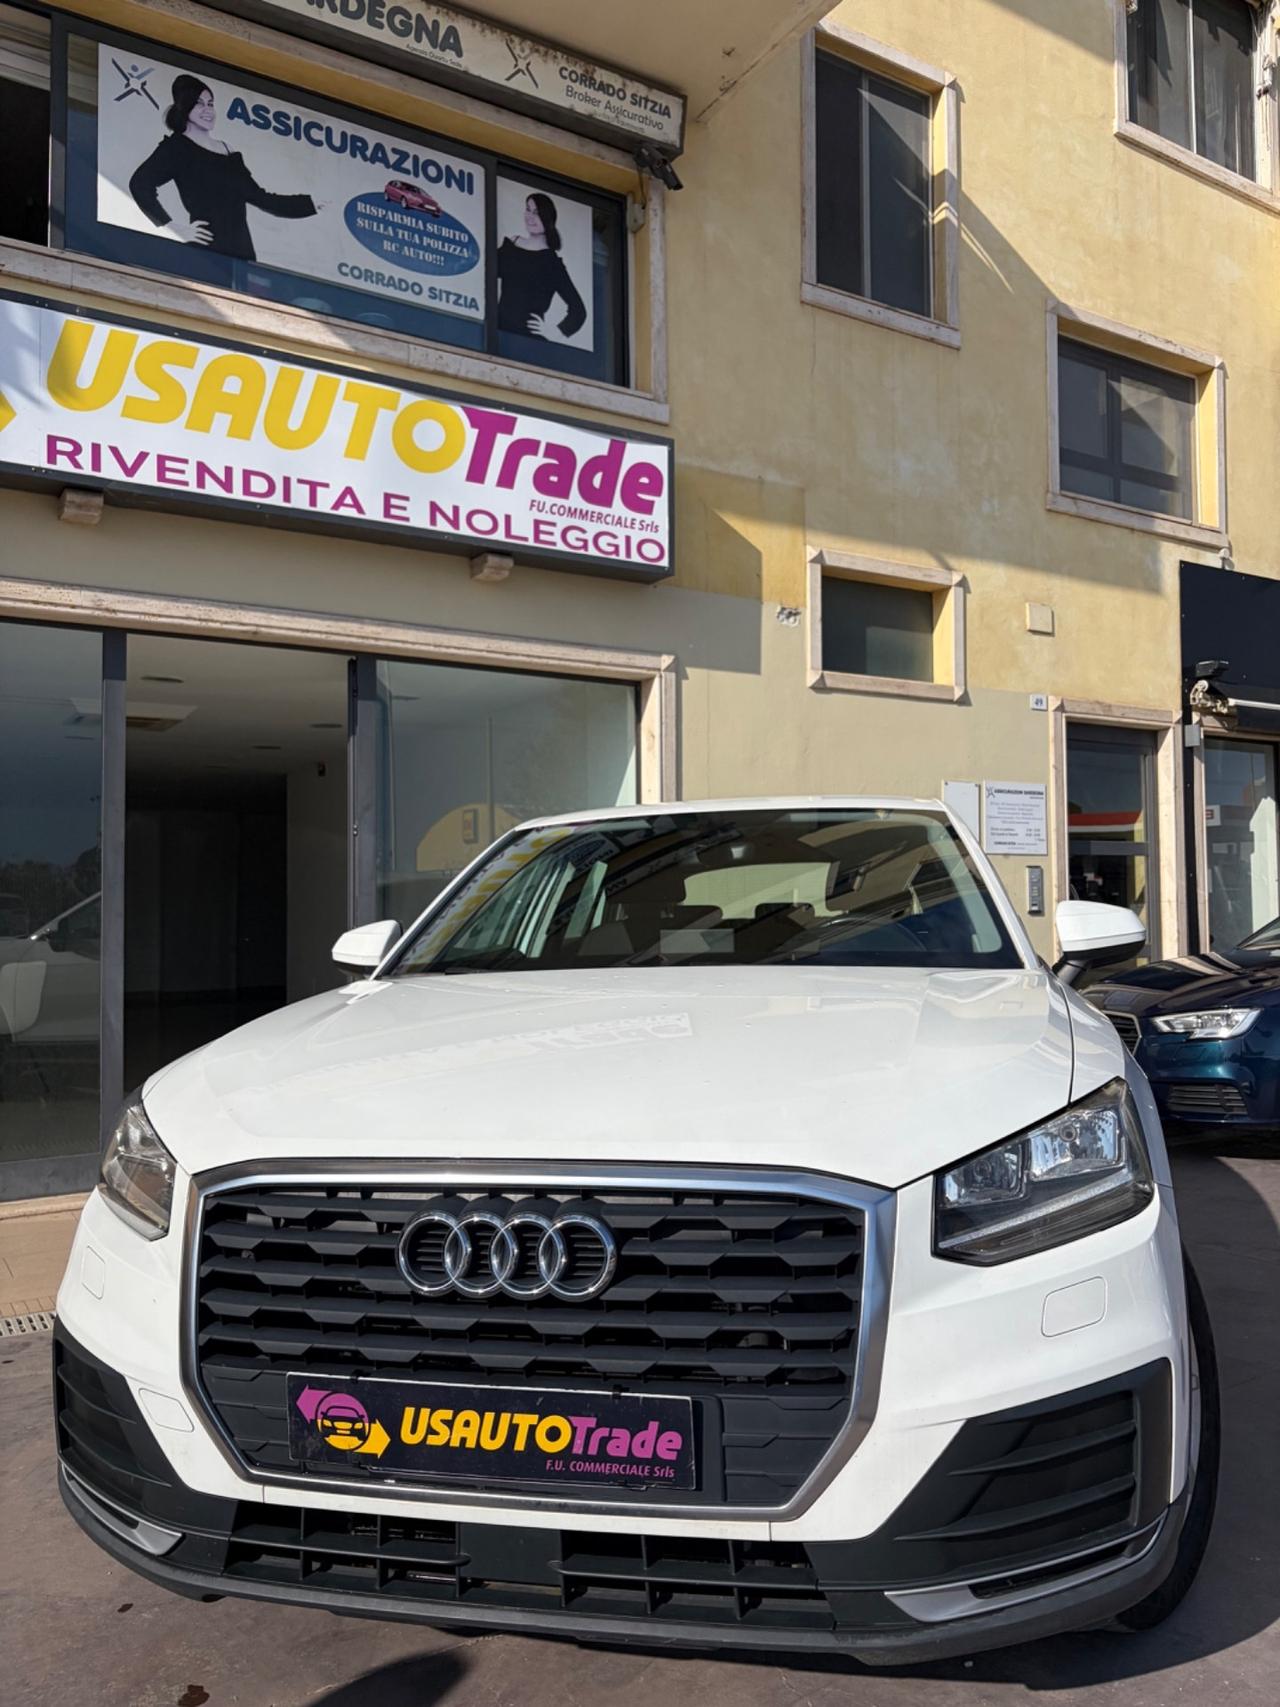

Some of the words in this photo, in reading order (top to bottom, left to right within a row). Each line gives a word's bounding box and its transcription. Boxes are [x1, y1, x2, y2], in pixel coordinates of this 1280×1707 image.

[306, 0, 463, 58] DEGNA
[558, 66, 627, 101] CORRADO
[630, 92, 672, 119] SITZIA
[565, 85, 602, 108] Broker
[604, 100, 664, 131] Assicurativo
[227, 97, 474, 195] ASSICURAZIONI
[356, 217, 394, 237] SULLA
[397, 229, 420, 245] TUA
[423, 236, 469, 259] POLIZZA
[357, 201, 424, 230] RISPARMIA
[426, 222, 469, 243] SUBITO
[383, 240, 400, 253] RC
[402, 246, 445, 266] AUTO!!!
[337, 262, 423, 296] CORRADO
[428, 286, 480, 312] SITZIA
[46, 434, 366, 515] RIVENDITA
[383, 492, 410, 522] E
[429, 501, 665, 563] NOLEGGIO
[638, 519, 660, 533] Srls
[546, 1459, 566, 1471] F.U.
[569, 1461, 651, 1478] COMMERCIALE
[653, 1465, 675, 1478] Srls
